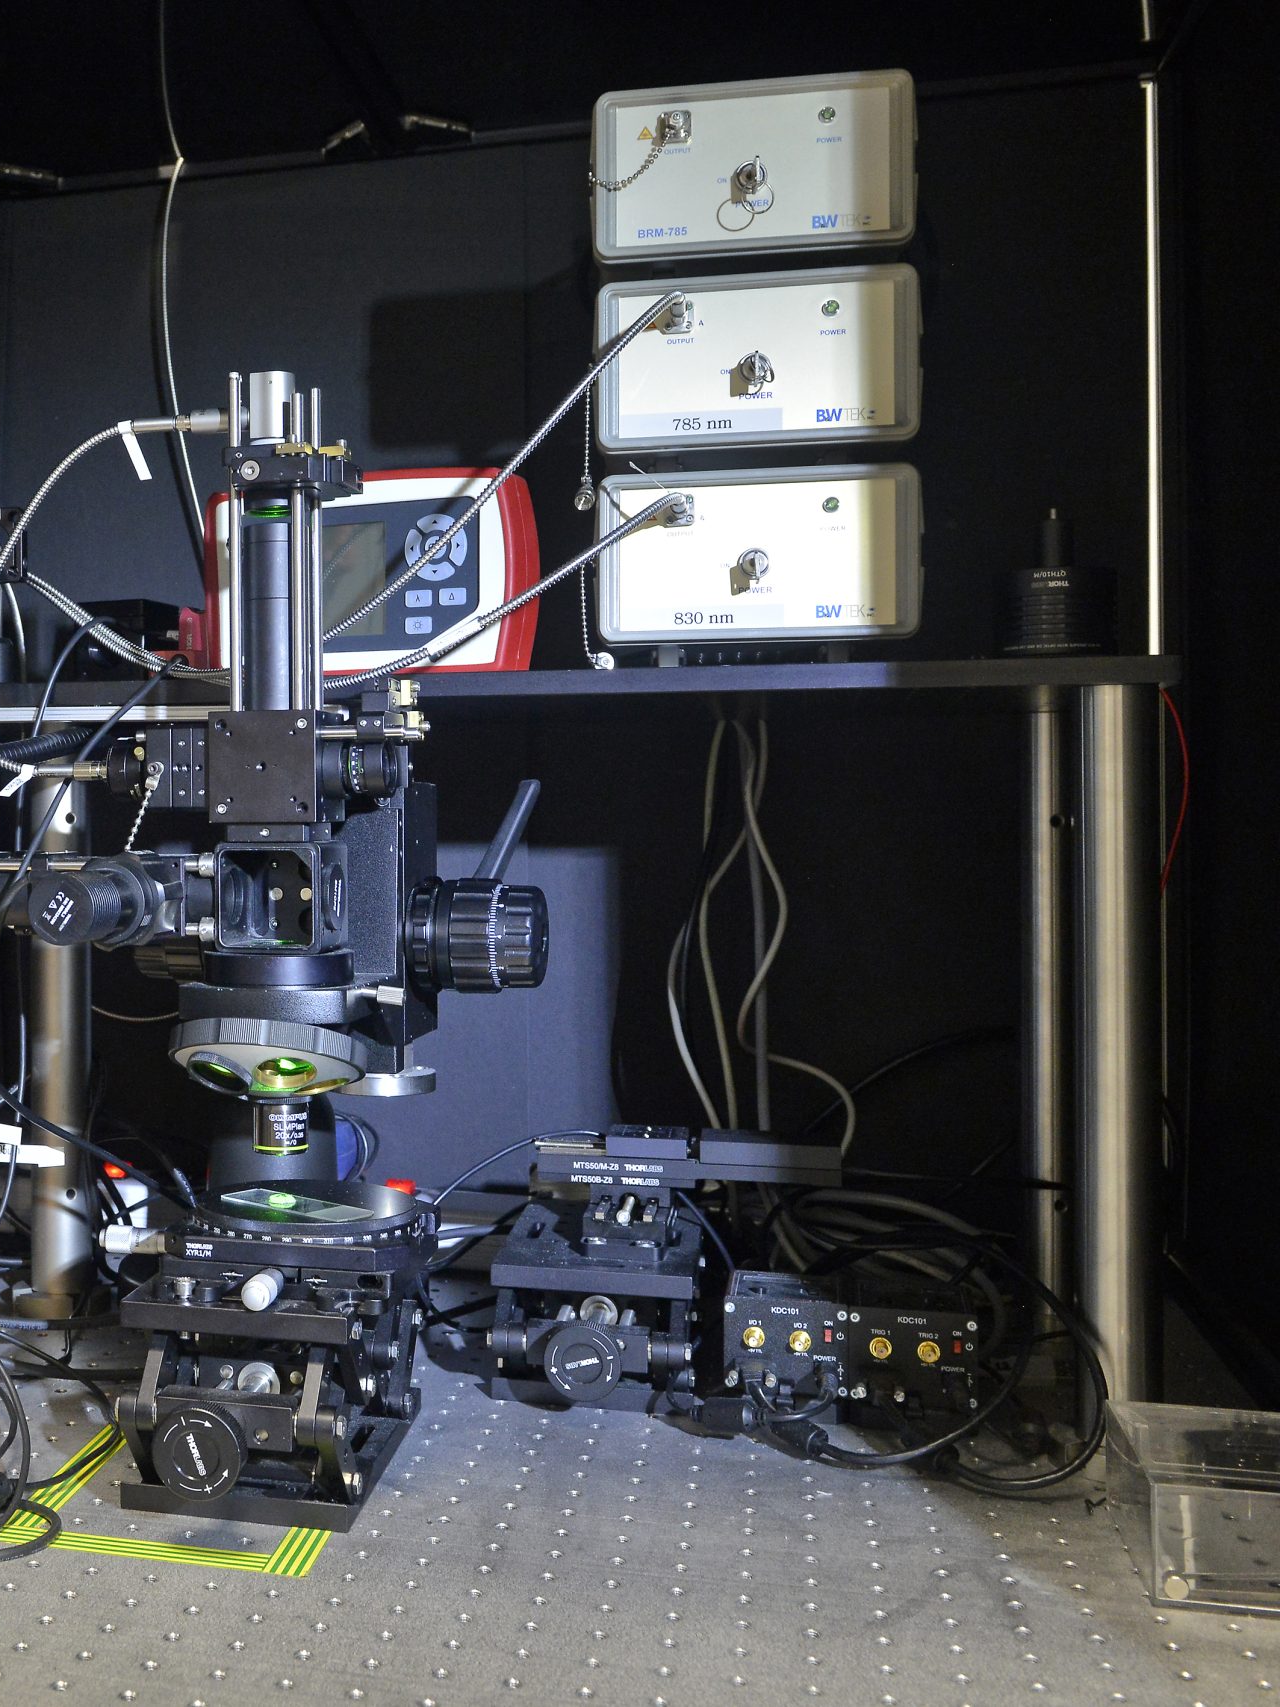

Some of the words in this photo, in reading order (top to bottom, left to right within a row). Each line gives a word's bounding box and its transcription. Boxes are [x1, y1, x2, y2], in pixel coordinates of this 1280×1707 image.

[637, 226, 688, 239] BRM-785
[820, 328, 846, 336] POWER
[666, 337, 695, 345] OUTPUT
[738, 391, 773, 400] POWER
[843, 407, 866, 421] TEK
[672, 417, 702, 431] 785
[707, 417, 733, 430] nm
[1033, 570, 1066, 578] QTH10/M
[738, 586, 773, 594] POWER
[674, 612, 703, 625] 830
[709, 612, 734, 624] nm
[269, 1112, 308, 1122] OLYMPUS
[273, 1122, 305, 1131] SLMPlan
[573, 1161, 620, 1171] MTS50/M-Z8
[624, 1163, 664, 1173] THORLABS
[570, 1174, 613, 1184] MTS50B-Z8
[621, 1176, 660, 1187] THORLABS
[185, 1248, 212, 1257] XYR1/M
[770, 1306, 799, 1315] KDC101
[897, 1316, 927, 1325] KDC101
[813, 1354, 837, 1362] POWER
[565, 1356, 600, 1370] THORLABS
[940, 1365, 965, 1373] POWER
[185, 1432, 207, 1477] THORLABS
